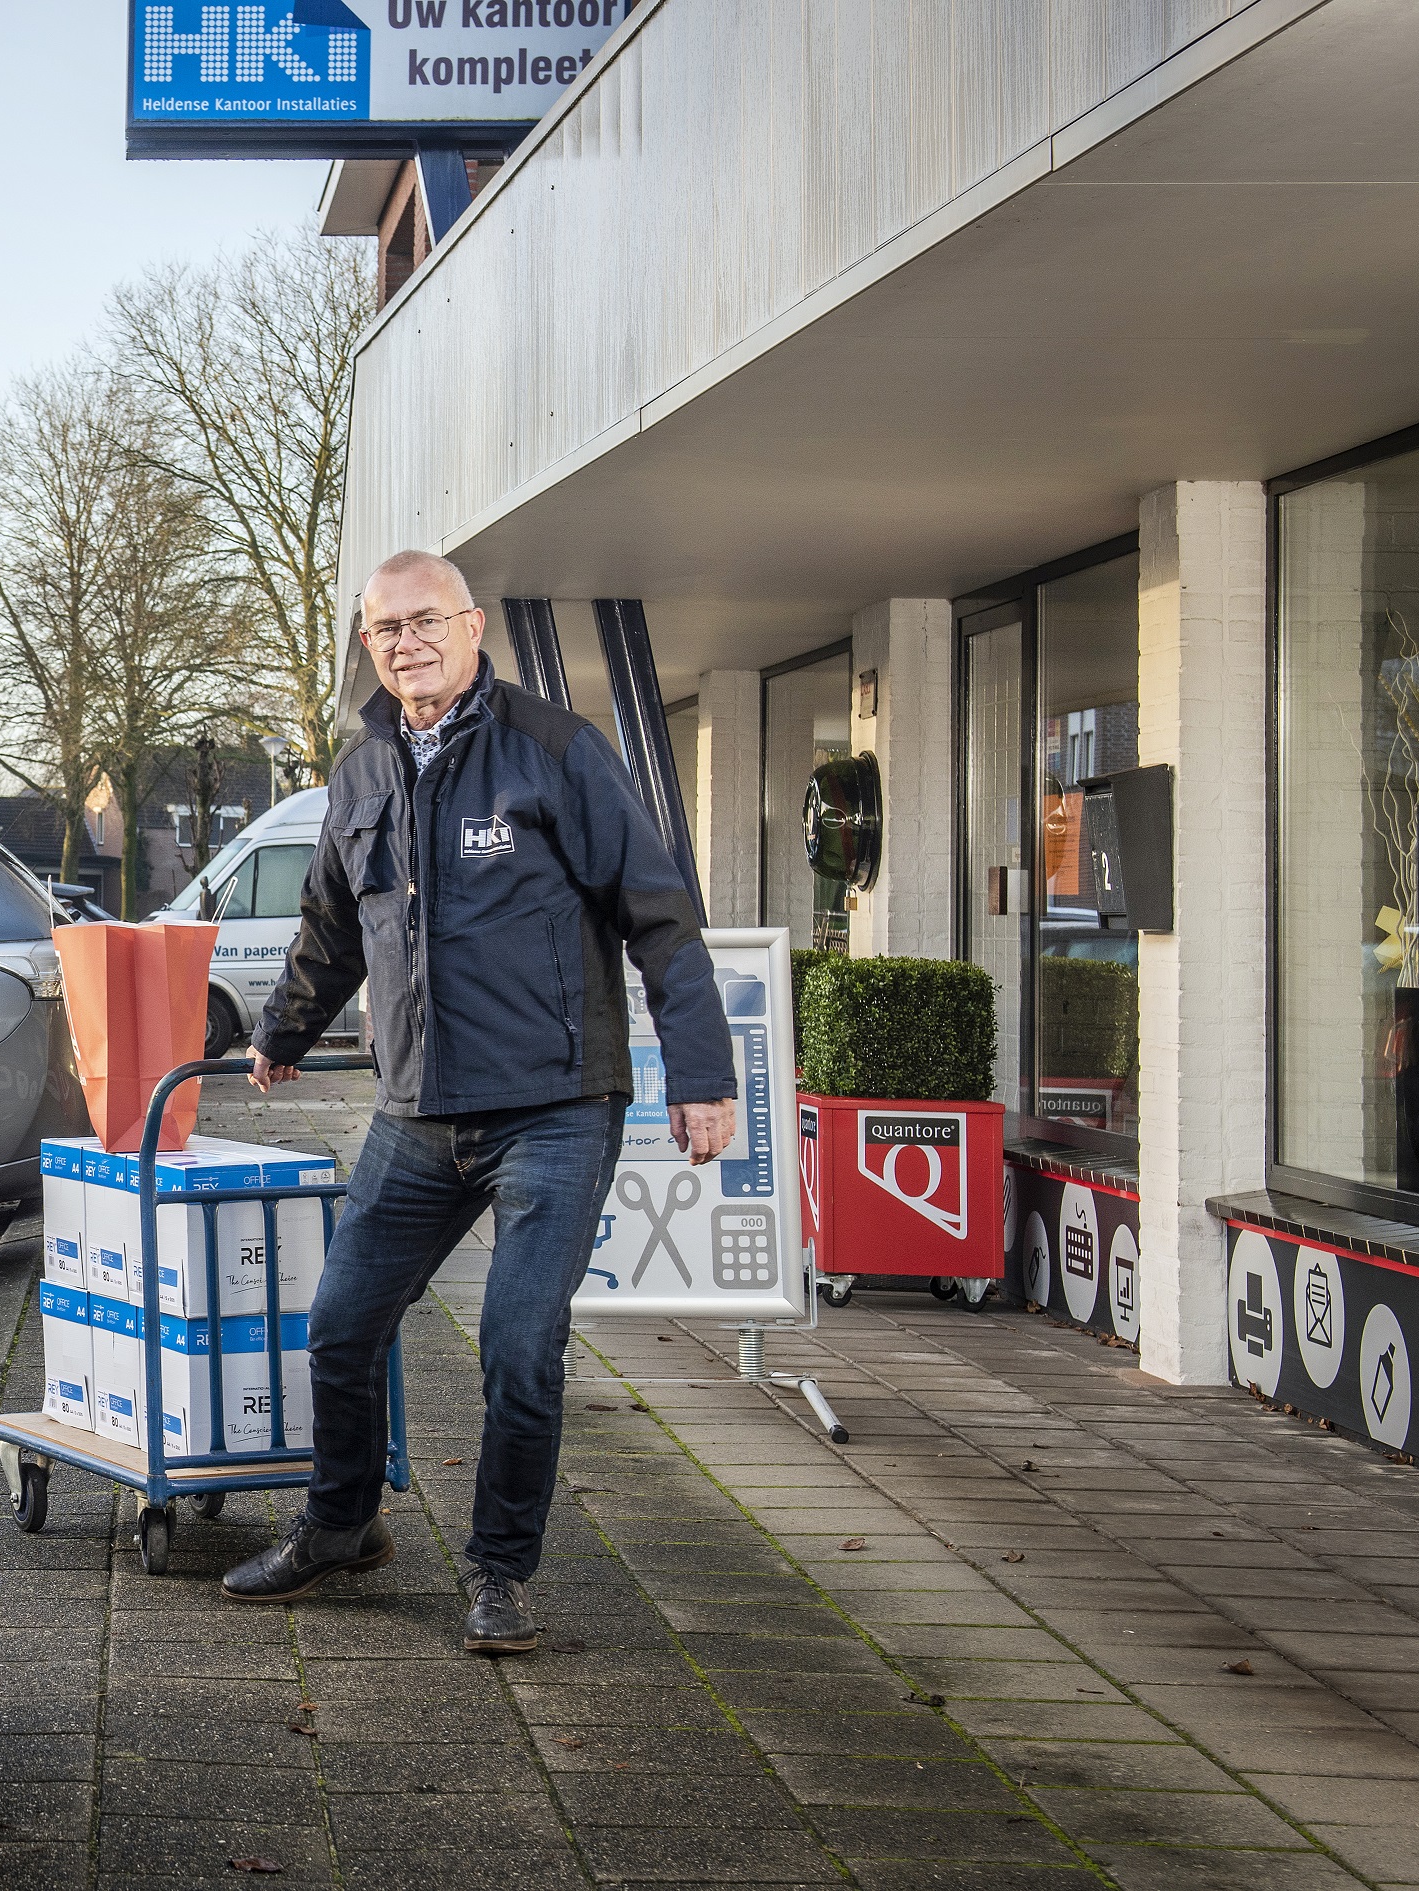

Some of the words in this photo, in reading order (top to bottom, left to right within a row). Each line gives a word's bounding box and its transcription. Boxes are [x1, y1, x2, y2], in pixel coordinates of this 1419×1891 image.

[388, 0, 447, 29] Uw
[462, 0, 618, 28] kantoor
[142, 97, 210, 112] Heldense
[215, 97, 272, 112] Kantoor
[276, 96, 357, 111] Installaties
[1100, 851, 1112, 891] 2
[214, 945, 238, 957] Van
[248, 979, 276, 987] www.h
[636, 1110, 663, 1118] Kantoor
[871, 1123, 952, 1140] quantore
[71, 1162, 80, 1174] A4
[115, 1171, 124, 1183] A4
[129, 1174, 140, 1188] RE
[133, 1265, 143, 1278] RE
[76, 1305, 86, 1318] A4
[125, 1318, 135, 1331] A4
[176, 1333, 186, 1347] A4
